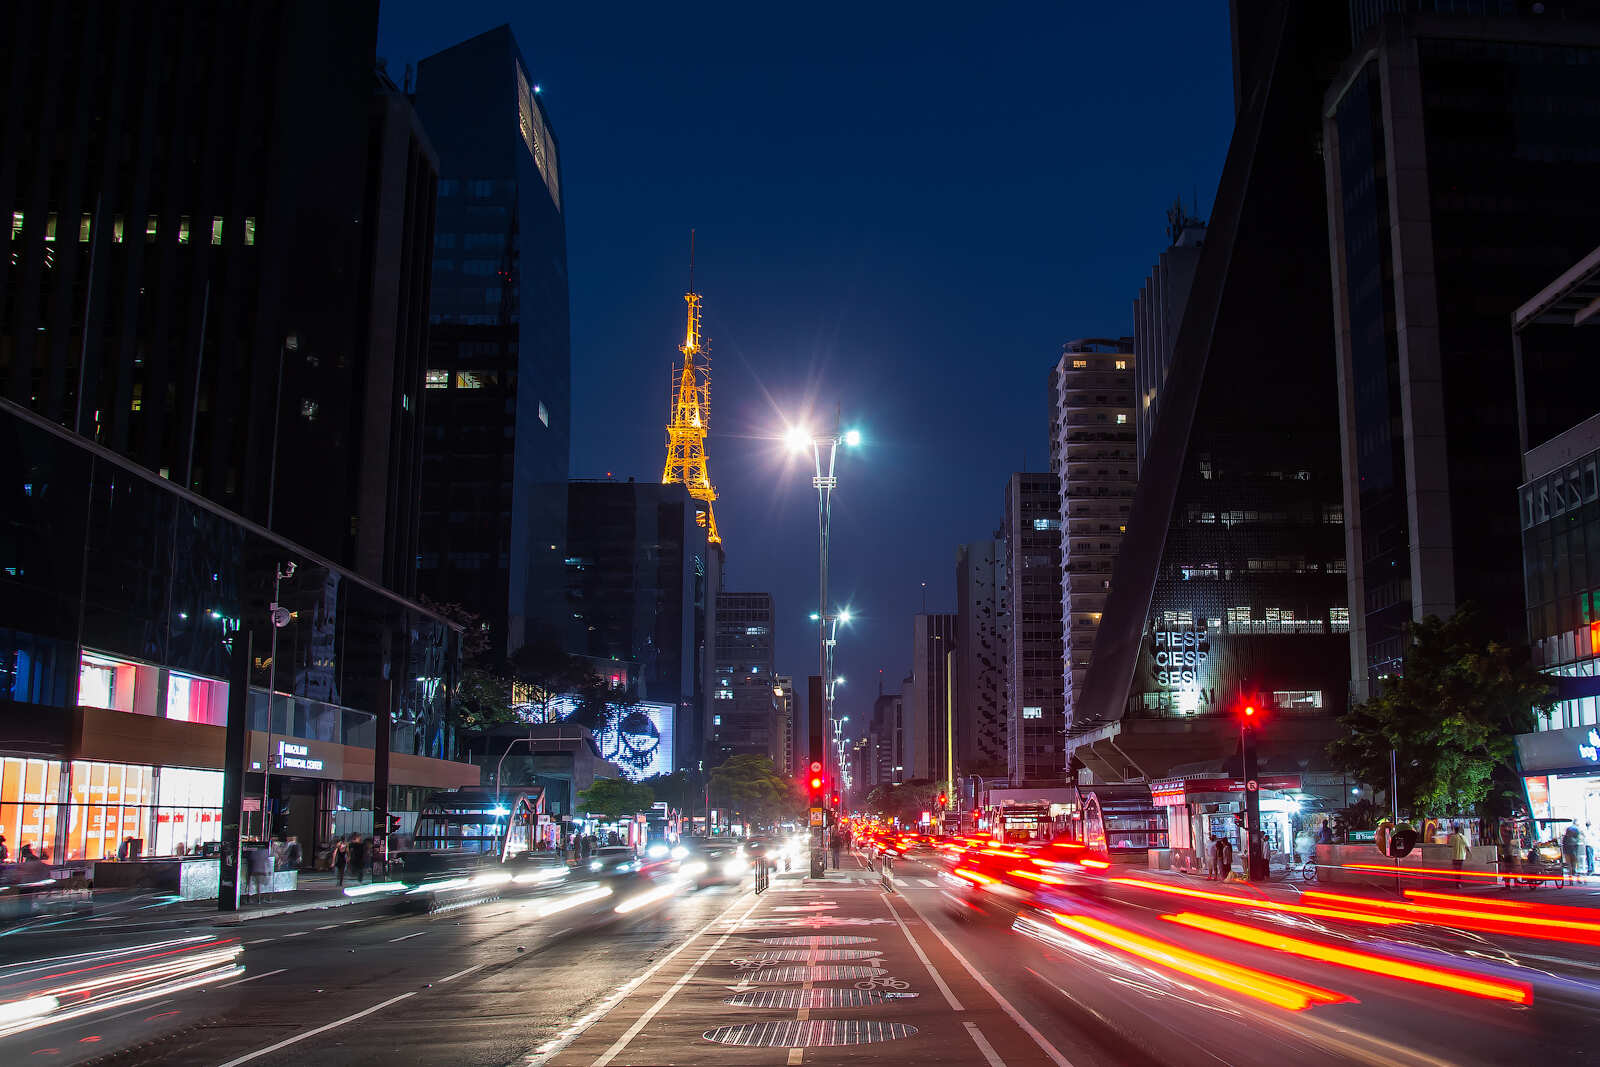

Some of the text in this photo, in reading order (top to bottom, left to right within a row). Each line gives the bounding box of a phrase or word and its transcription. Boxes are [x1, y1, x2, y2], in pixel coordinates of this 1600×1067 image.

[1155, 631, 1208, 647] FIESP
[1155, 650, 1209, 667] CIESP
[1157, 671, 1197, 687] SESI
